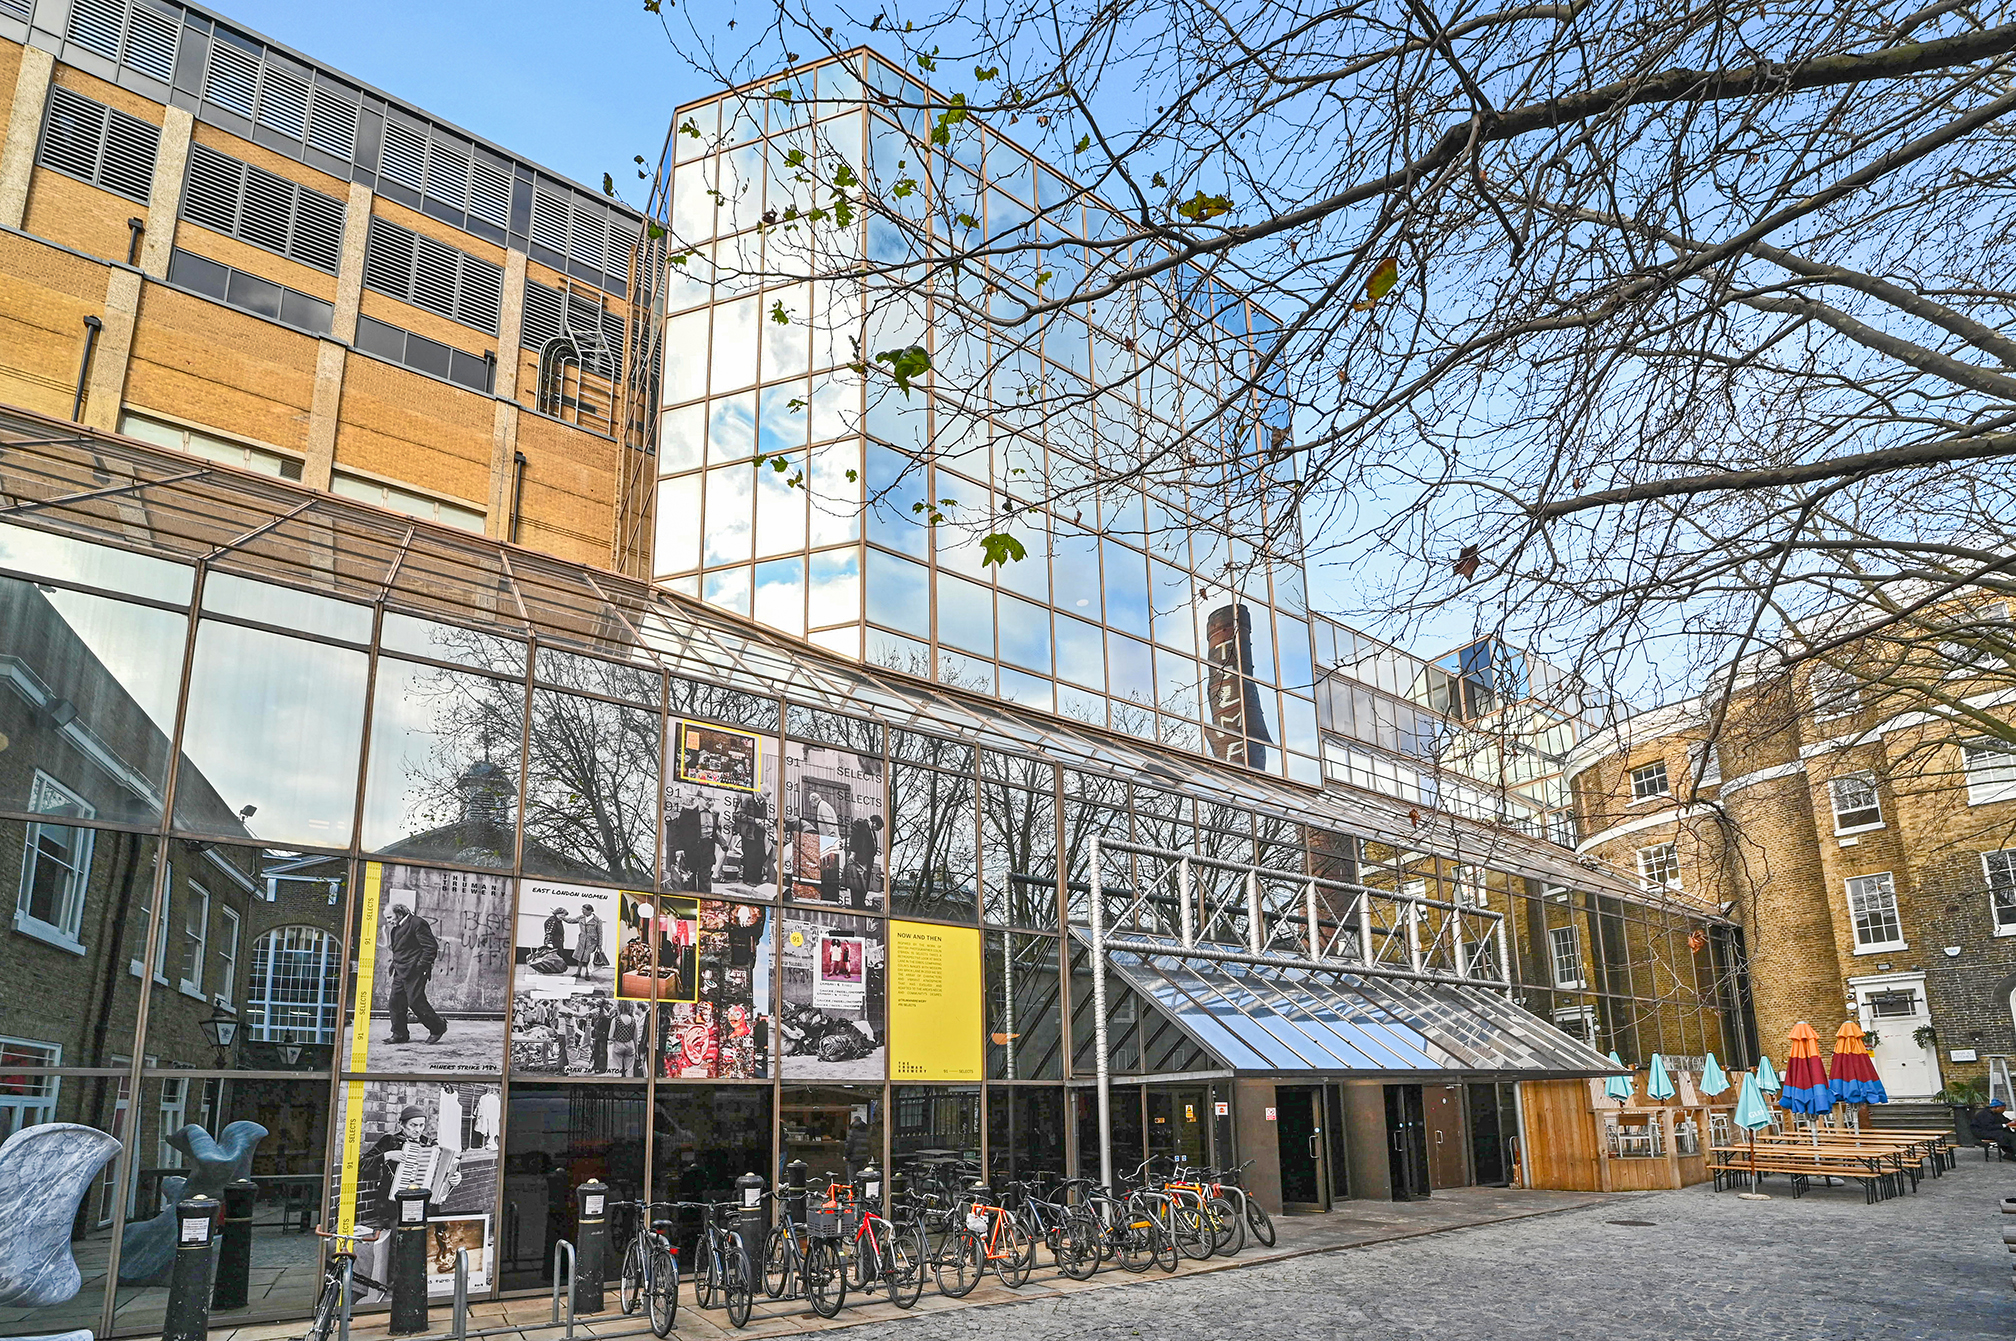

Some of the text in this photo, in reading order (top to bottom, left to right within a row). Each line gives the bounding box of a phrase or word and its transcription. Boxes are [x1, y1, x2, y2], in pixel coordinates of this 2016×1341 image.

[786, 756, 882, 784] 91 SELECTS
[666, 787, 681, 798] 91
[837, 791, 882, 807] SELECTS
[665, 801, 681, 812] 91
[443, 880, 497, 890] TRUMAN
[442, 886, 505, 896] BREWERY
[552, 889, 580, 897] LONDON
